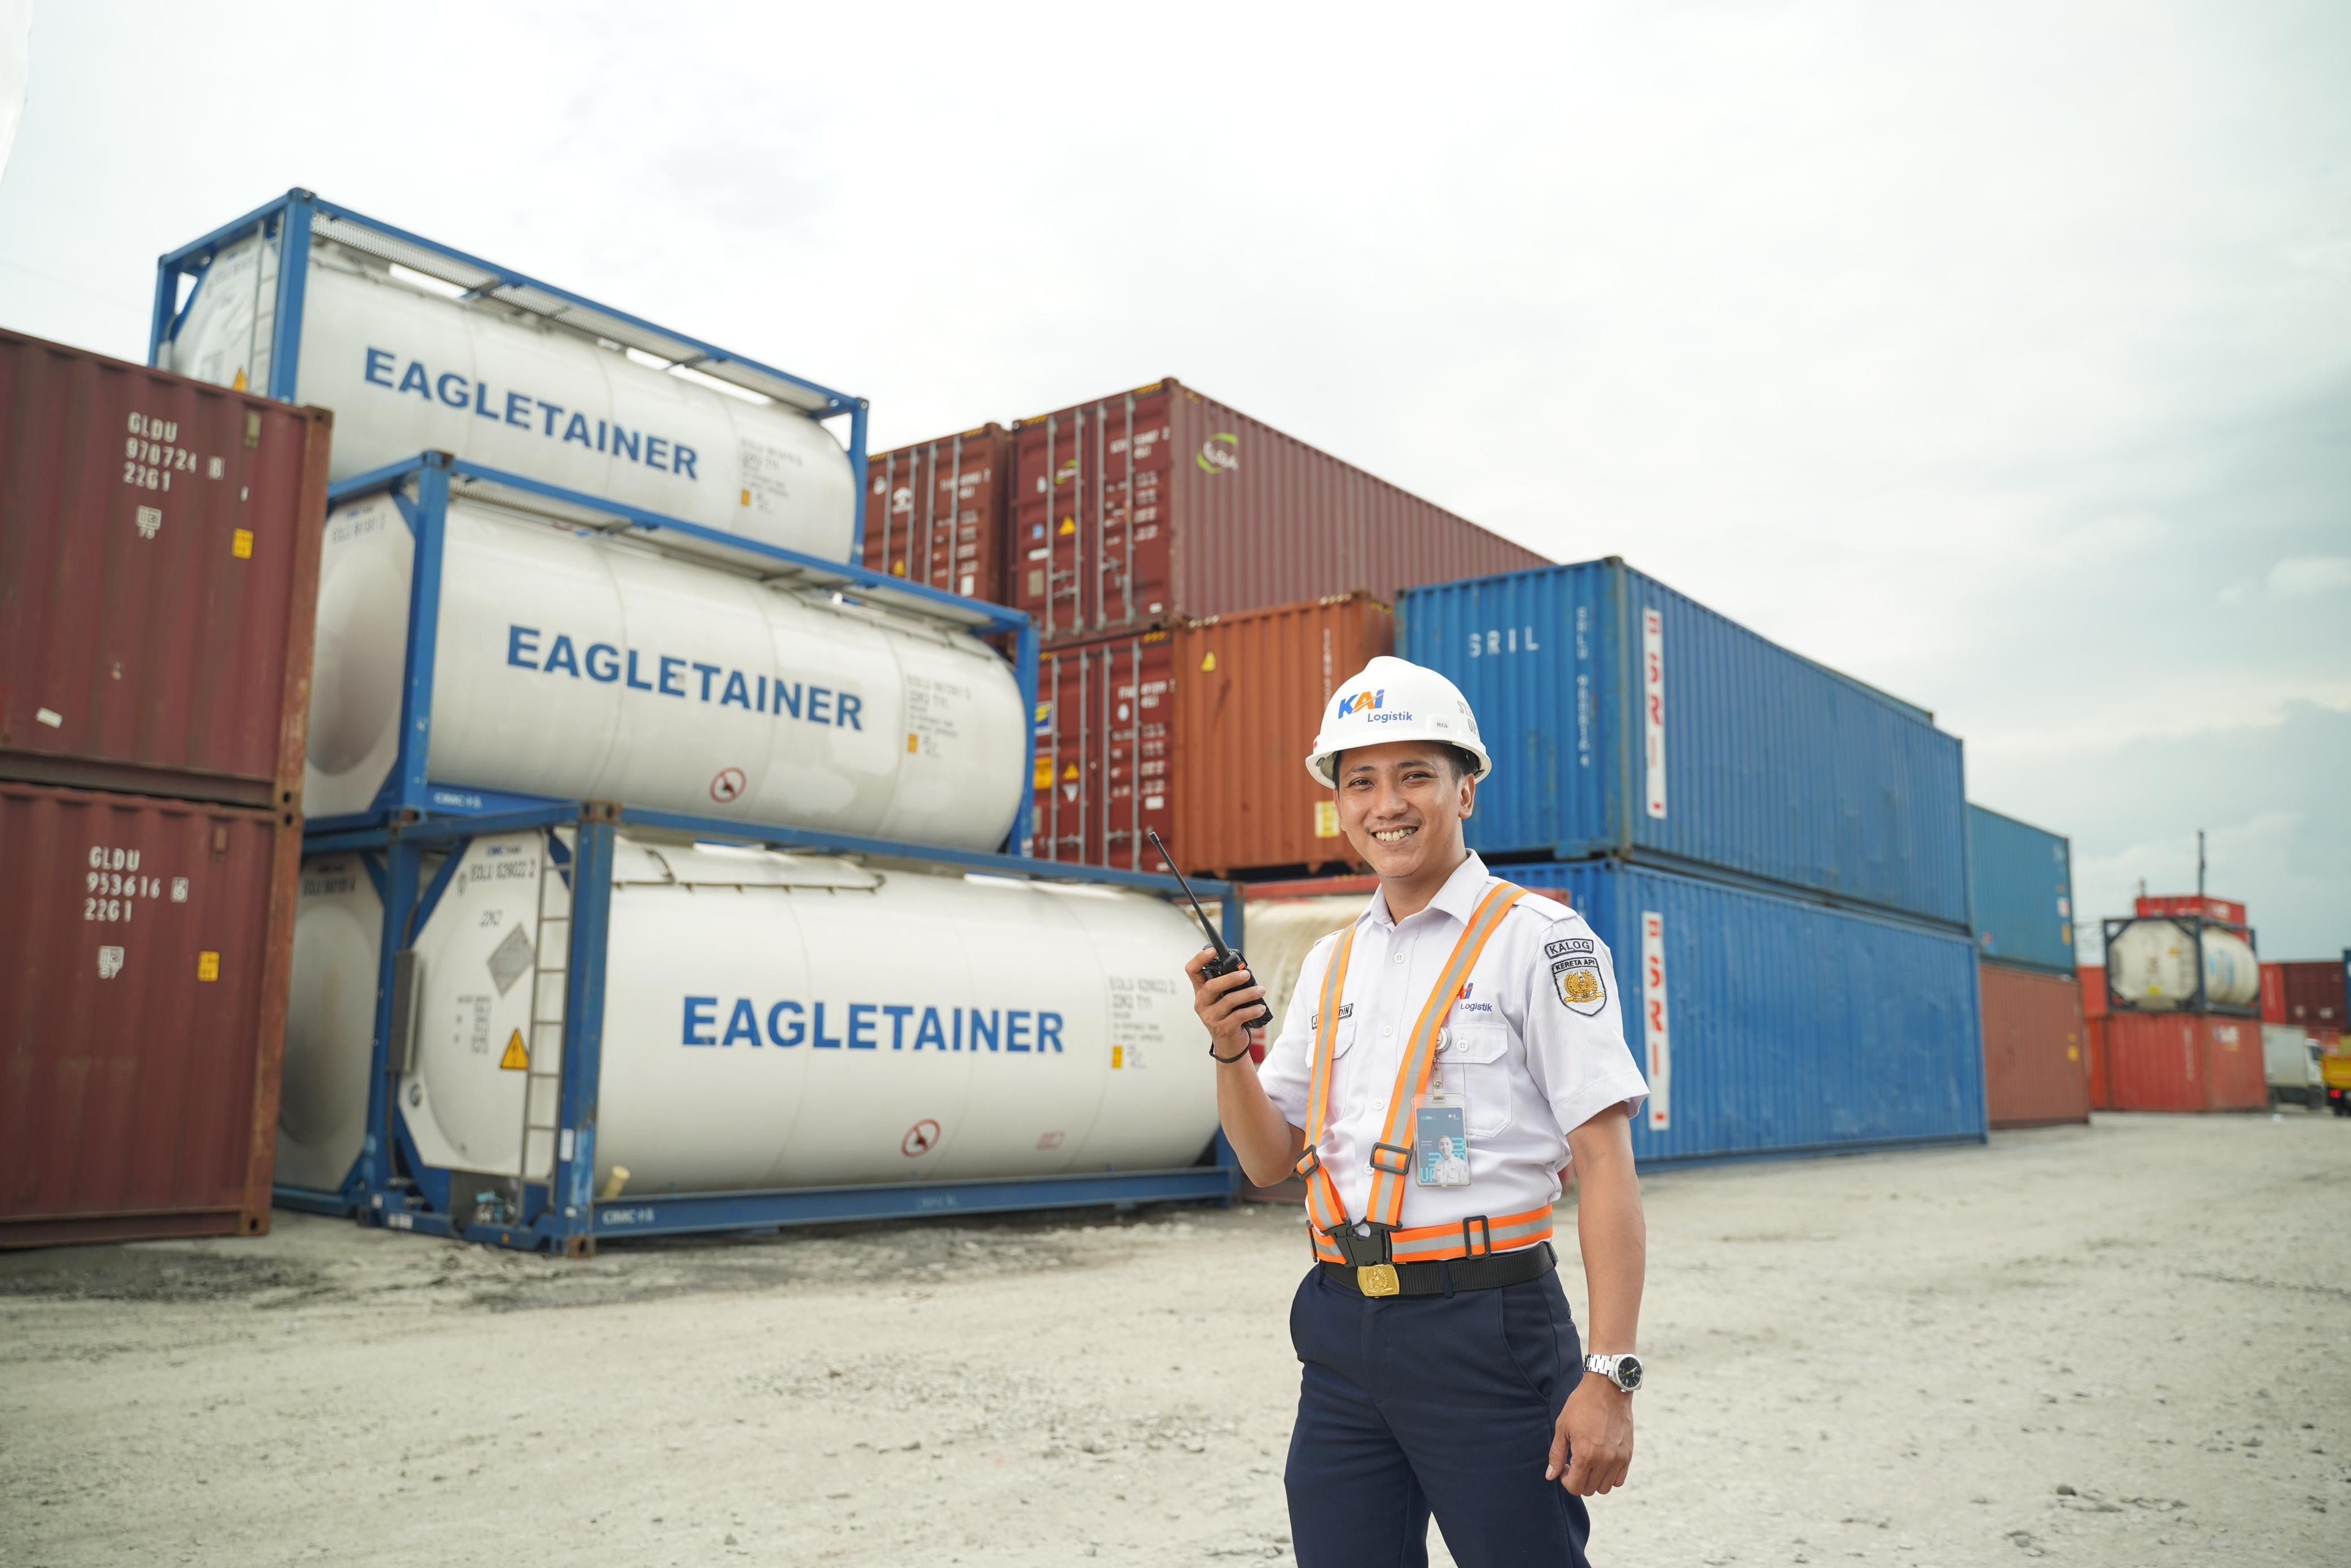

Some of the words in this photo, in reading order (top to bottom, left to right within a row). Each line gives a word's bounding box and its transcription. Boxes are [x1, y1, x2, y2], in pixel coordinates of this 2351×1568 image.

[127, 411, 178, 443] GLDU
[364, 347, 697, 480] EAGLETAINER
[126, 437, 197, 473] 970724
[123, 461, 171, 492] 22G1
[1469, 626, 1540, 658] SRIL
[507, 625, 863, 731] EAGLETAINER
[1338, 689, 1384, 719] KAI
[1368, 711, 1412, 723] Logistik
[89, 846, 140, 872] GLDU
[86, 872, 160, 899] 953616
[84, 897, 132, 923] 22G1
[1550, 941, 1590, 954] KALOG
[1555, 959, 1582, 971] KERETA
[1460, 1002, 1492, 1011] Logistik
[682, 995, 1064, 1054] EAGLETAINER
